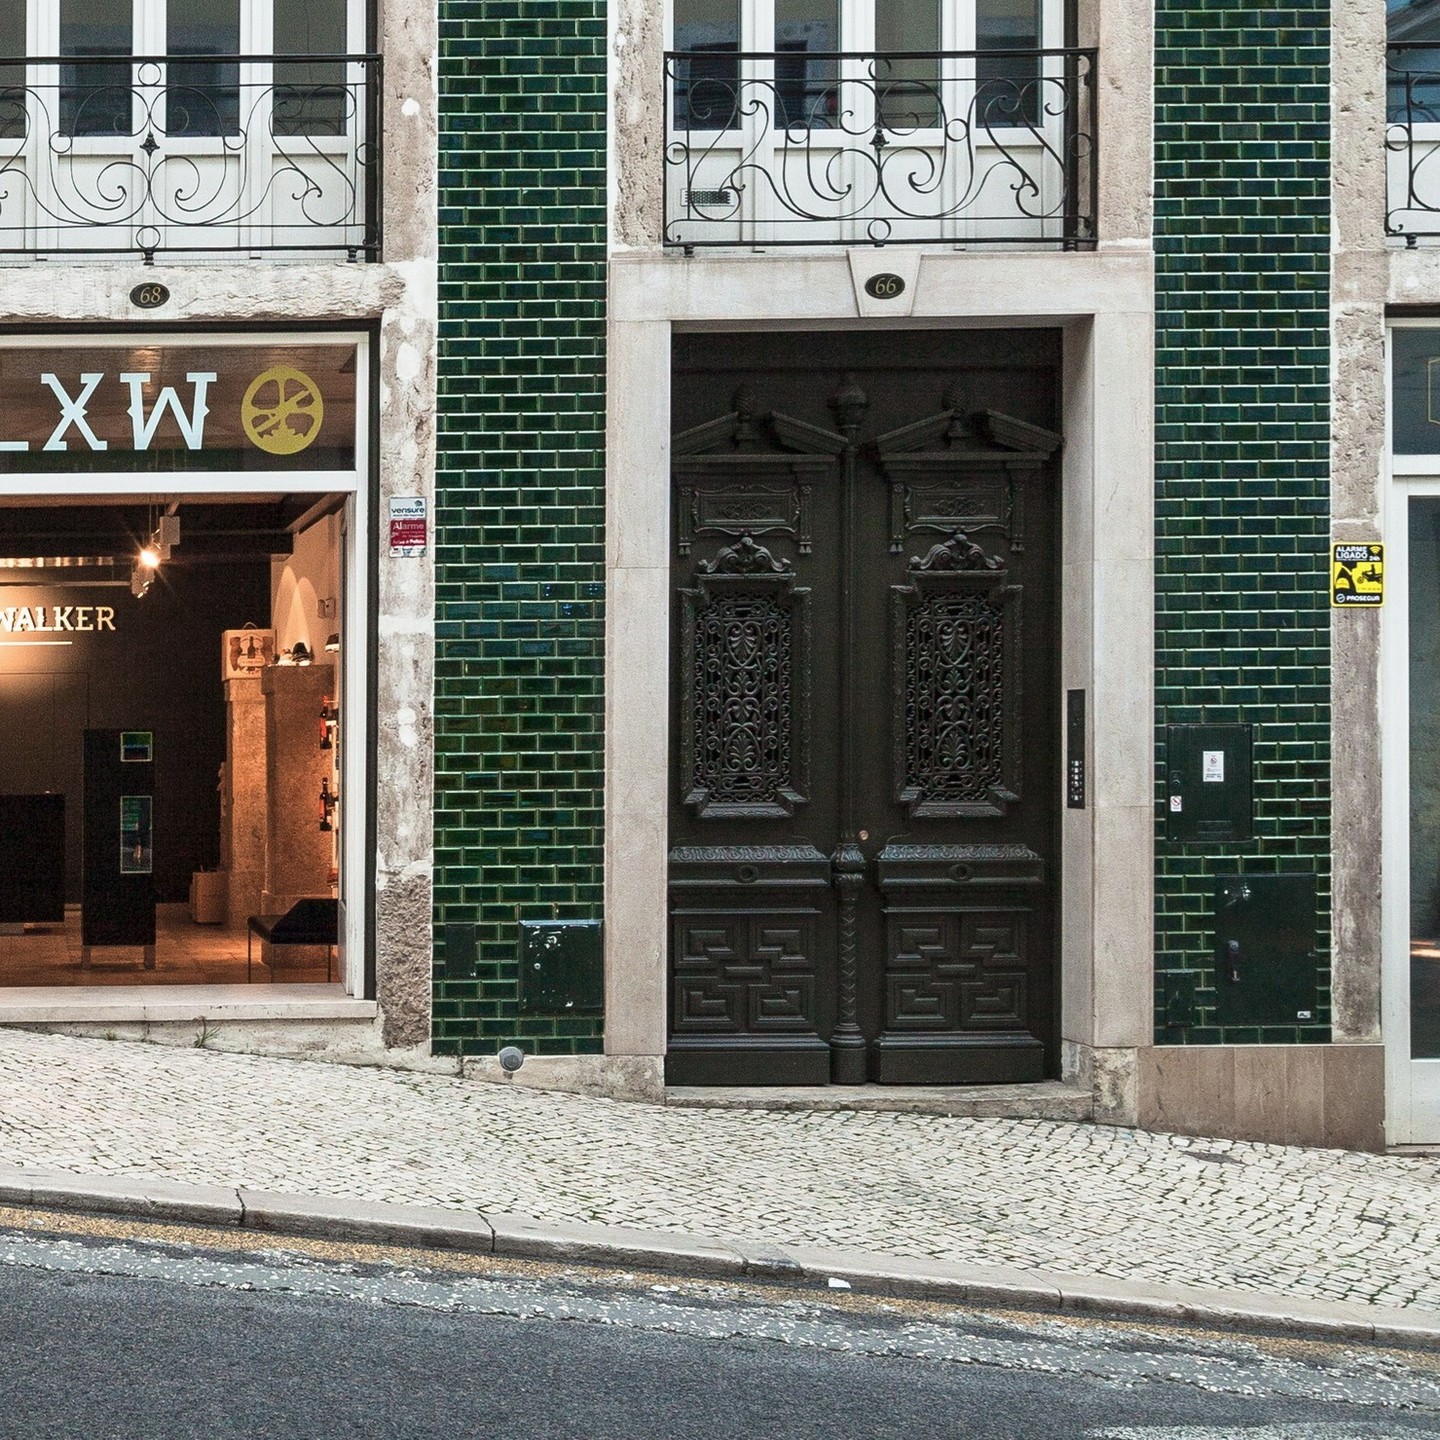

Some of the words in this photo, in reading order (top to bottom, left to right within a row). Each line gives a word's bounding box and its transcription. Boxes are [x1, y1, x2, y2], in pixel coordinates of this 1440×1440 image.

[875, 276, 897, 295] 66
[140, 286, 161, 304] 68
[393, 522, 424, 530] Alarme
